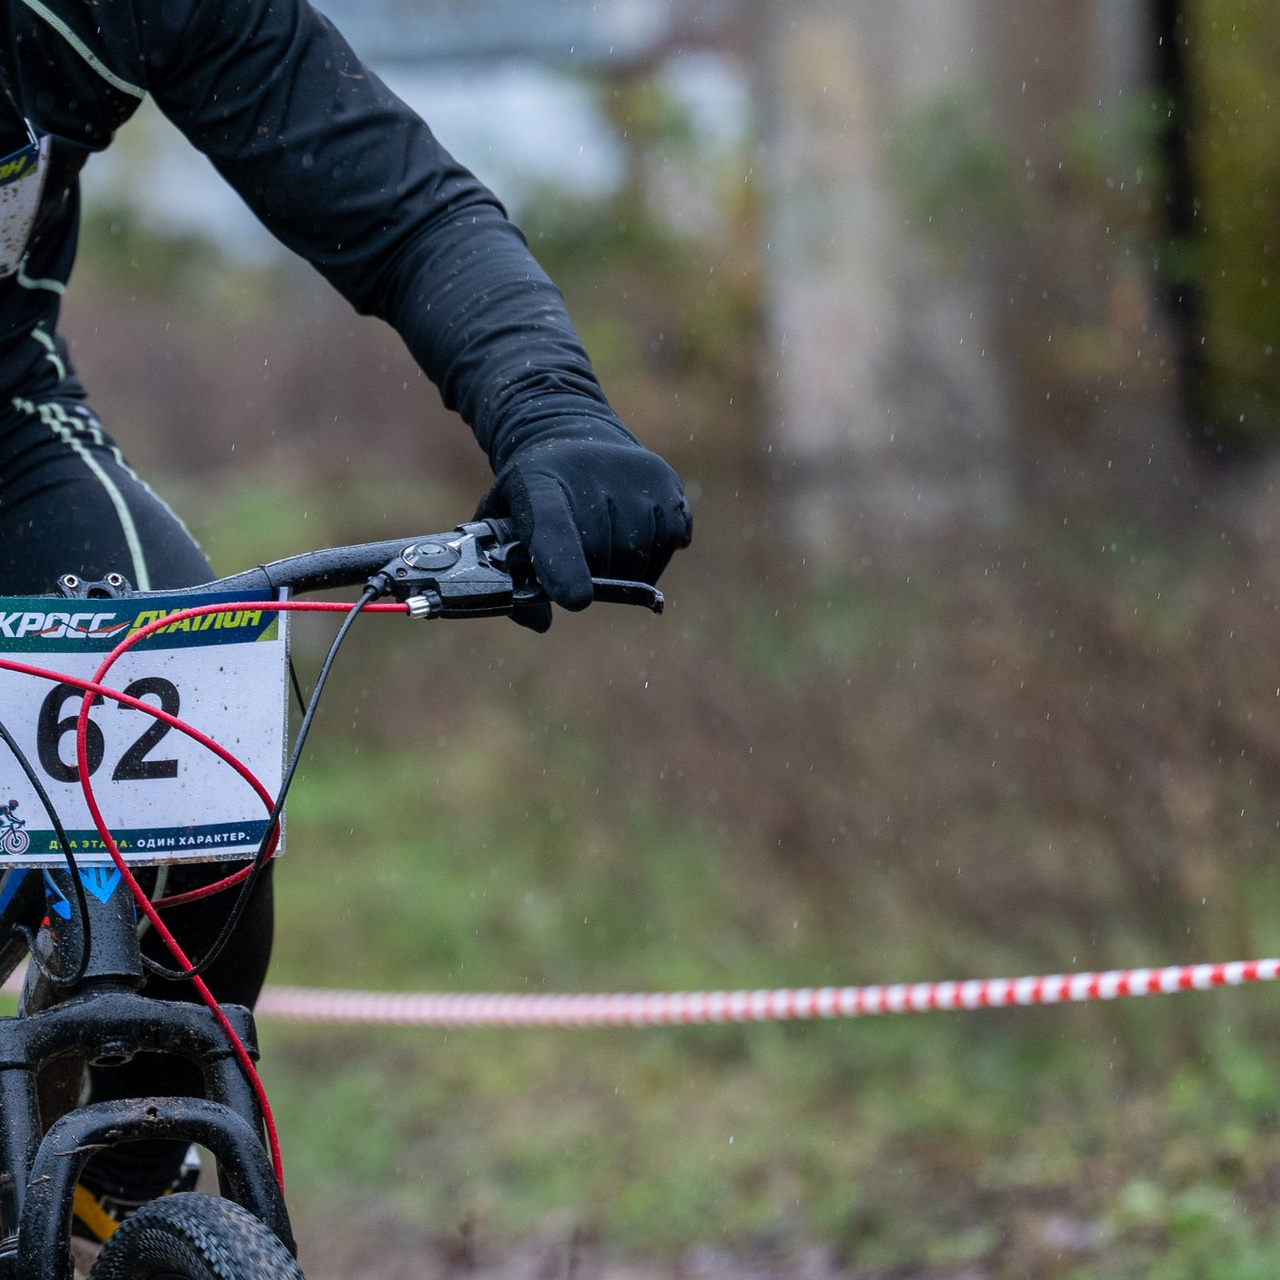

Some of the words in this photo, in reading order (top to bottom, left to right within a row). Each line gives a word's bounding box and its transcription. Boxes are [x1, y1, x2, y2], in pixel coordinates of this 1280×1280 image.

[37, 677, 180, 783] 62
[49, 840, 78, 850] ДА
[137, 837, 175, 848] ОДИН
[179, 832, 250, 846] ХАРАКТЕР.
